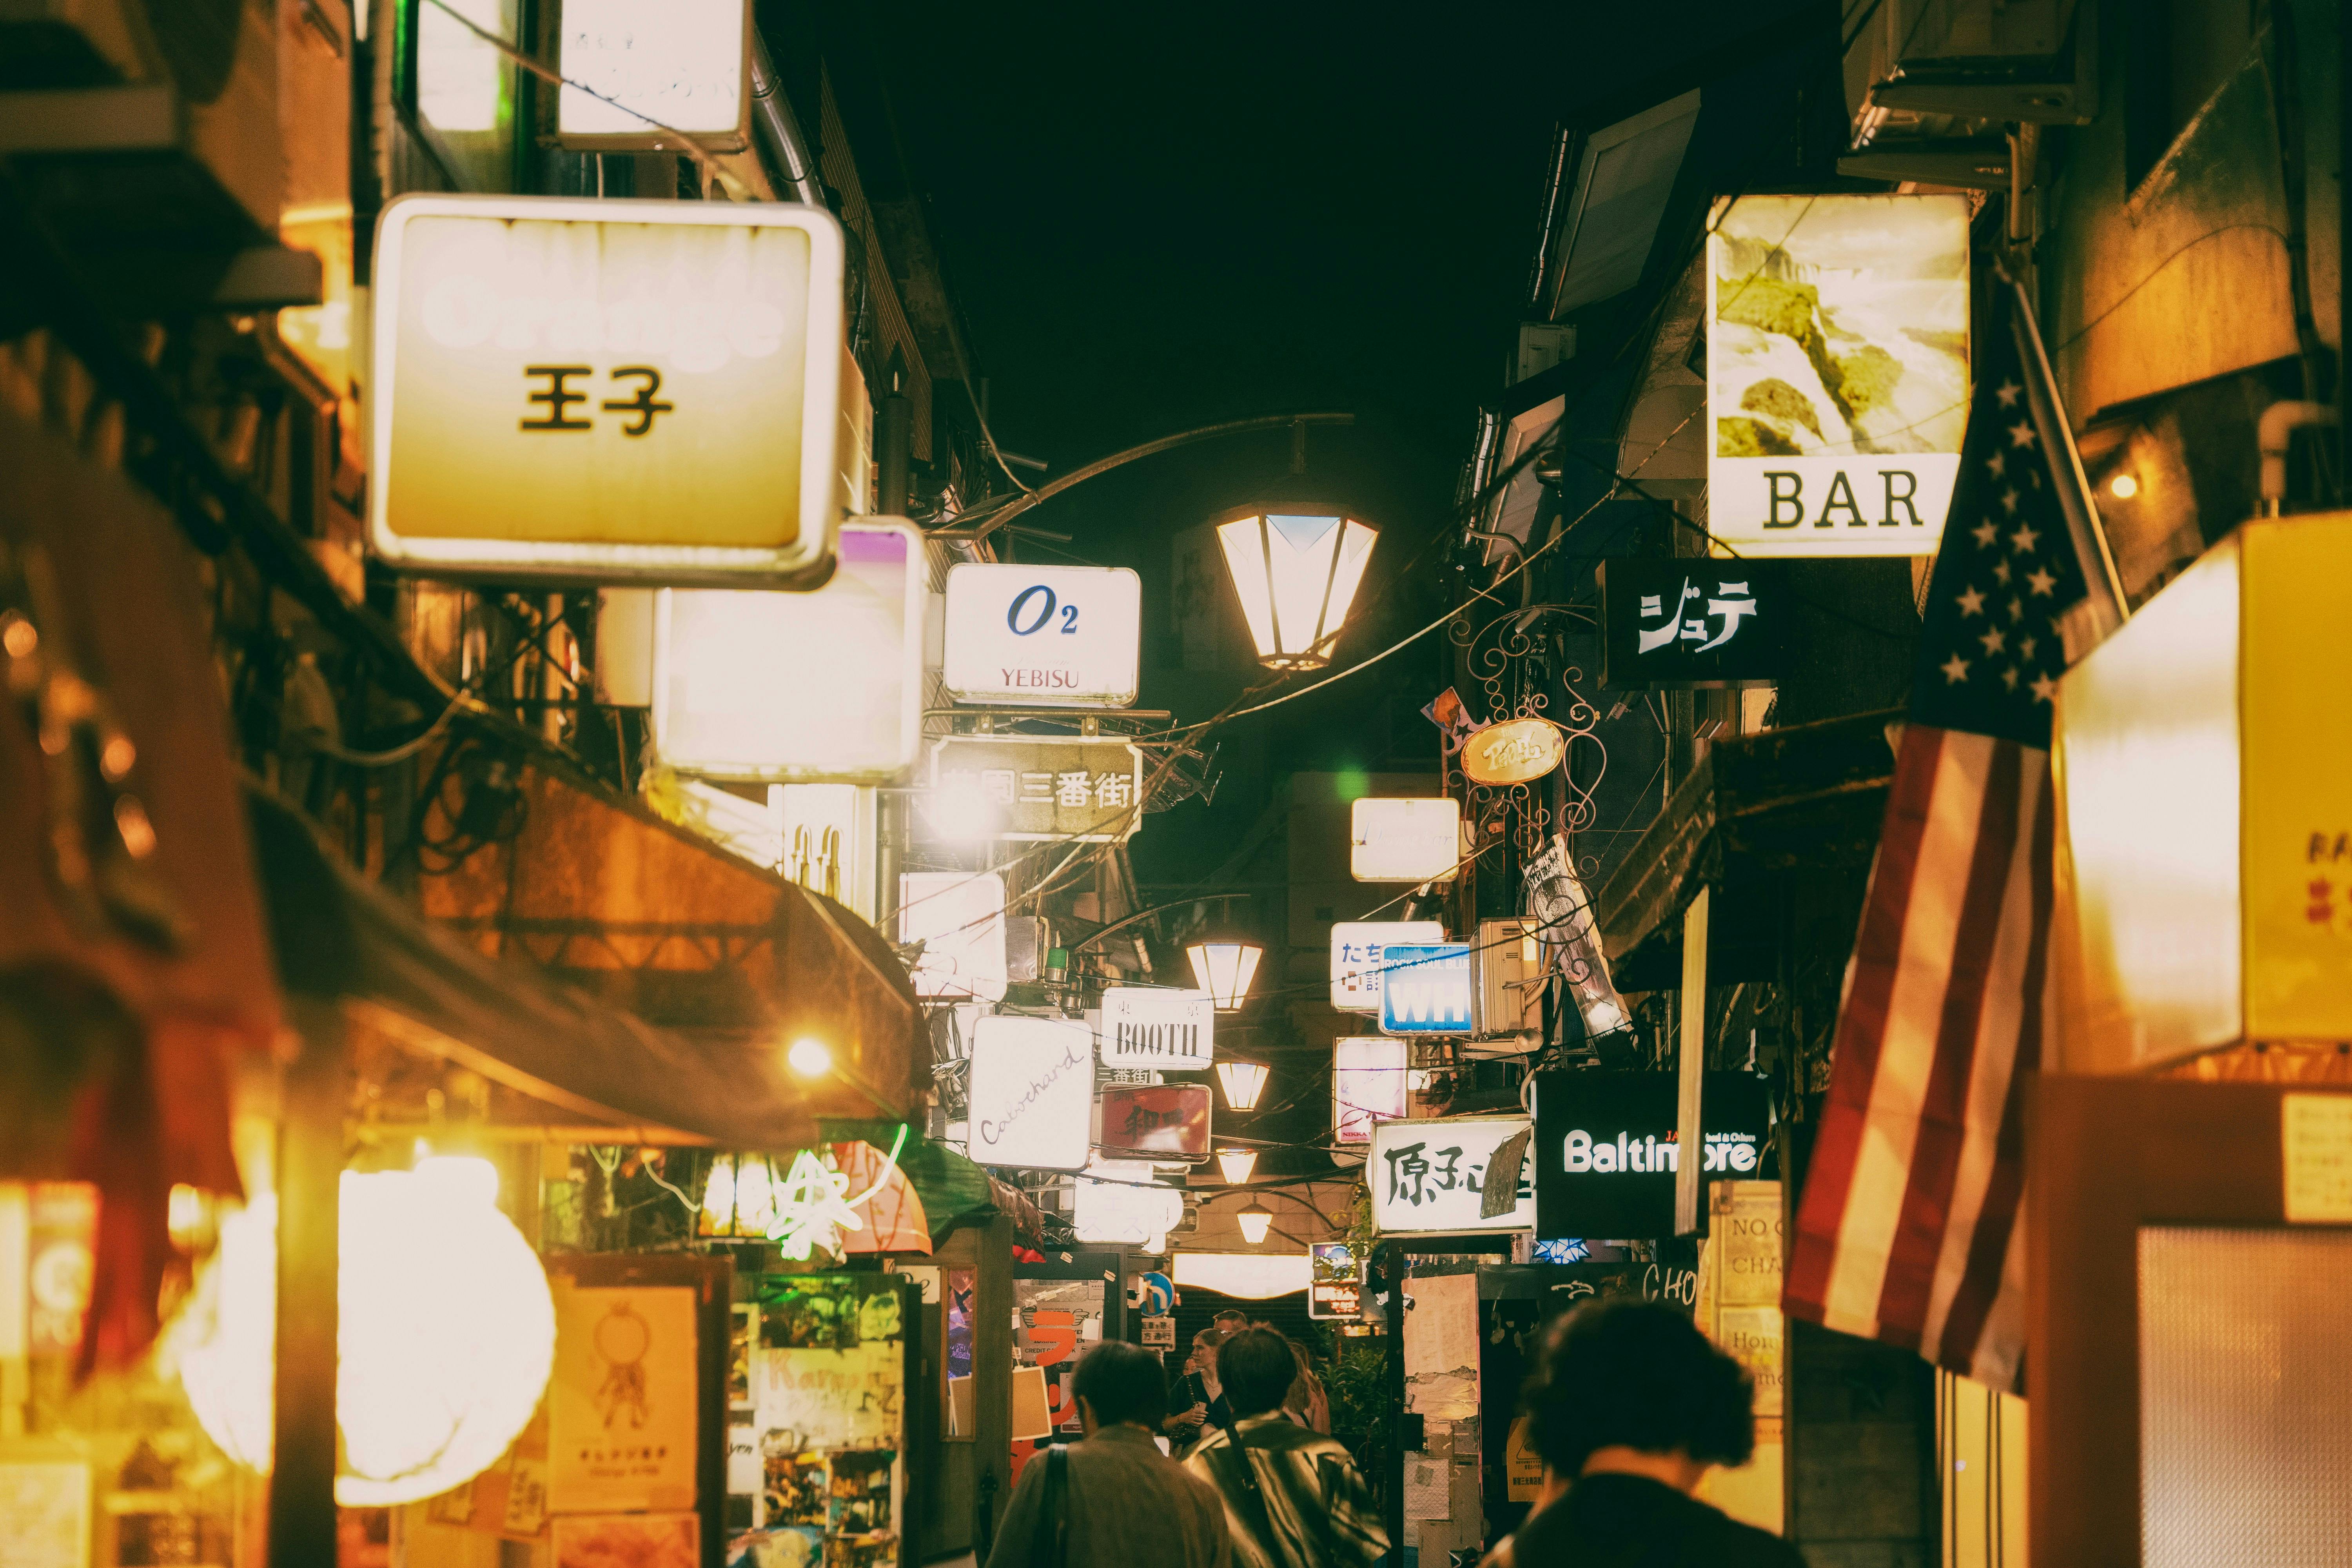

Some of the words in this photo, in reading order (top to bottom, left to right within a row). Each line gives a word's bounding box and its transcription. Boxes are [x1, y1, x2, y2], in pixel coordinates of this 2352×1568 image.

[520, 366, 672, 436] 王子
[1763, 470, 1924, 530] BAR
[1638, 575, 1757, 654] ジュテ
[1002, 668, 1079, 688] YEBISU
[942, 769, 1132, 809] 園三番街
[1384, 959, 1414, 970] ROCK
[1416, 958, 1443, 970] SOUL
[1445, 958, 1470, 970] BLUE
[1388, 982, 1471, 1022] WH
[1116, 1022, 1198, 1056] BOOTH
[981, 1046, 1084, 1145] Cabochard
[1666, 1130, 1679, 1142] JA
[1733, 1219, 1767, 1236] NO
[1732, 1257, 1782, 1274] CHA
